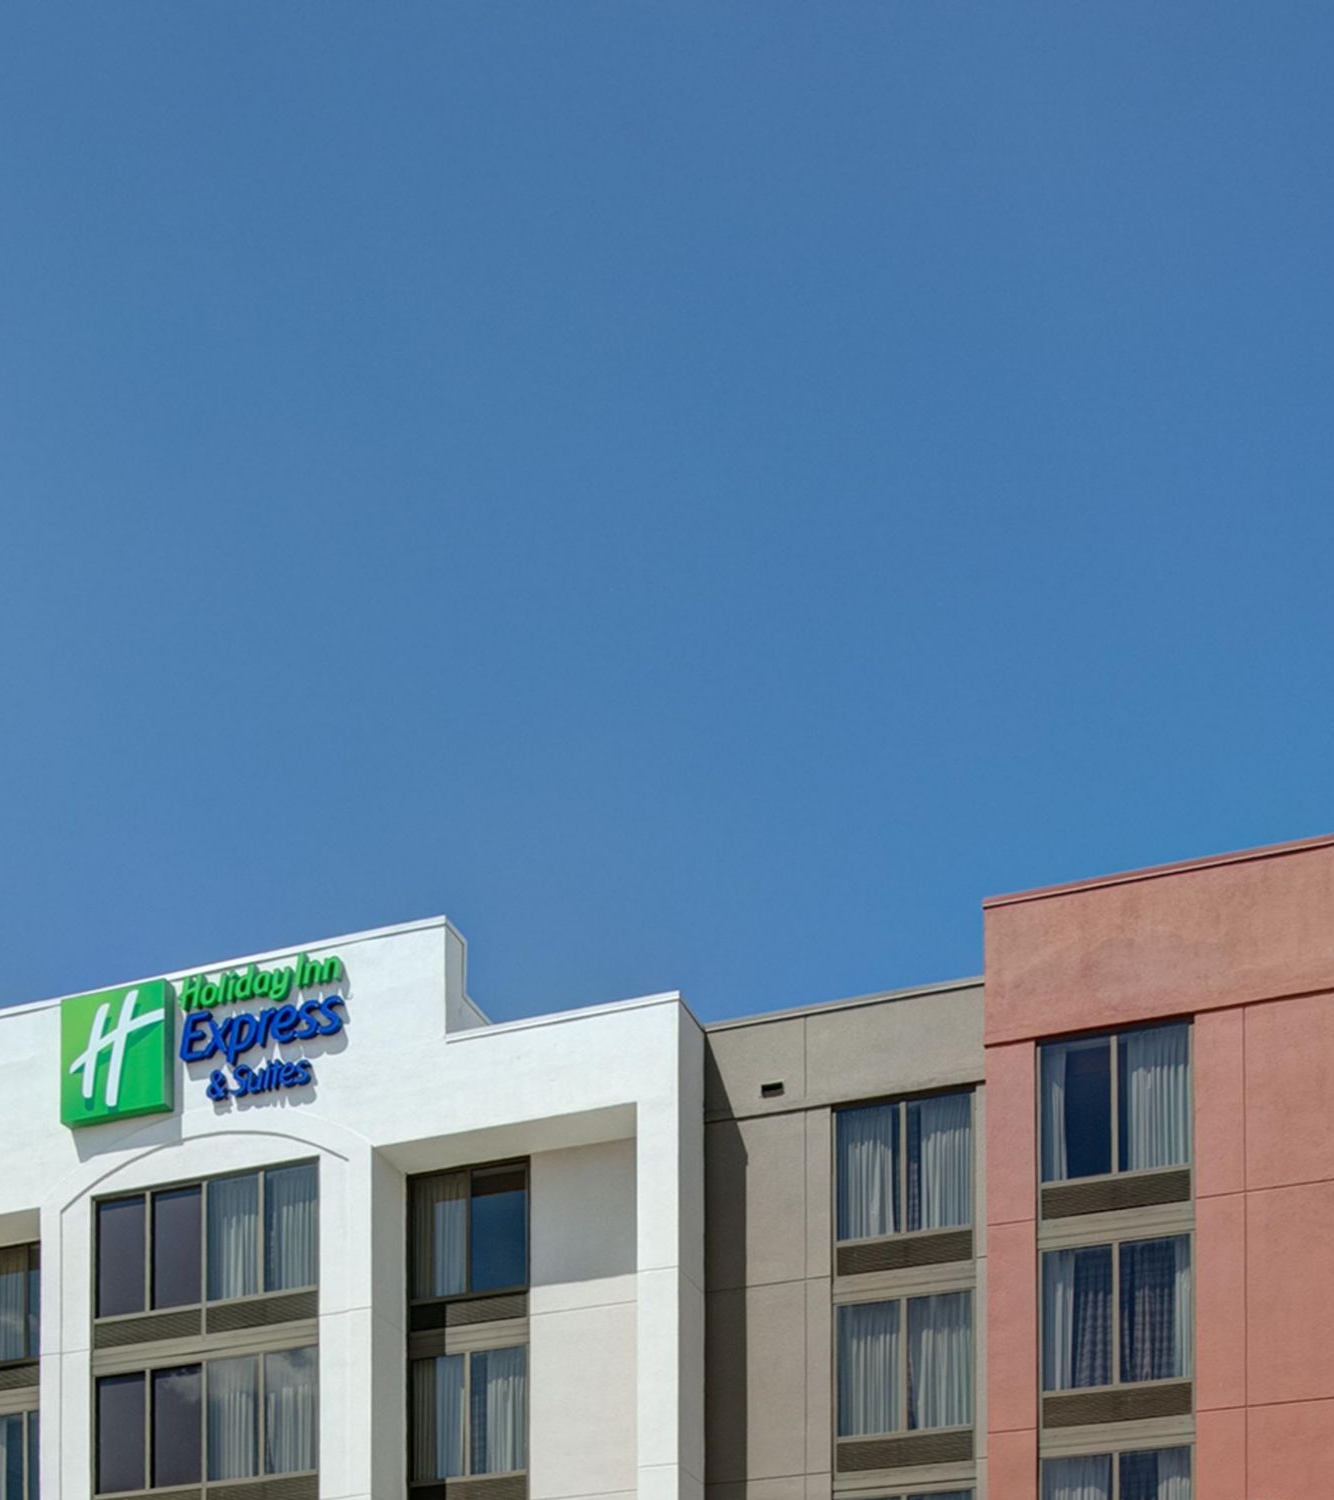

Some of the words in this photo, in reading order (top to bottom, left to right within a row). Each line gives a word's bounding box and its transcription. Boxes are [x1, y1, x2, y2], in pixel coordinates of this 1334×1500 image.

[178, 962, 294, 1012] Holiday
[295, 952, 344, 988] Inn
[180, 994, 344, 1066] Express
[206, 1069, 229, 1102] &
[230, 1059, 313, 1098] Suites
